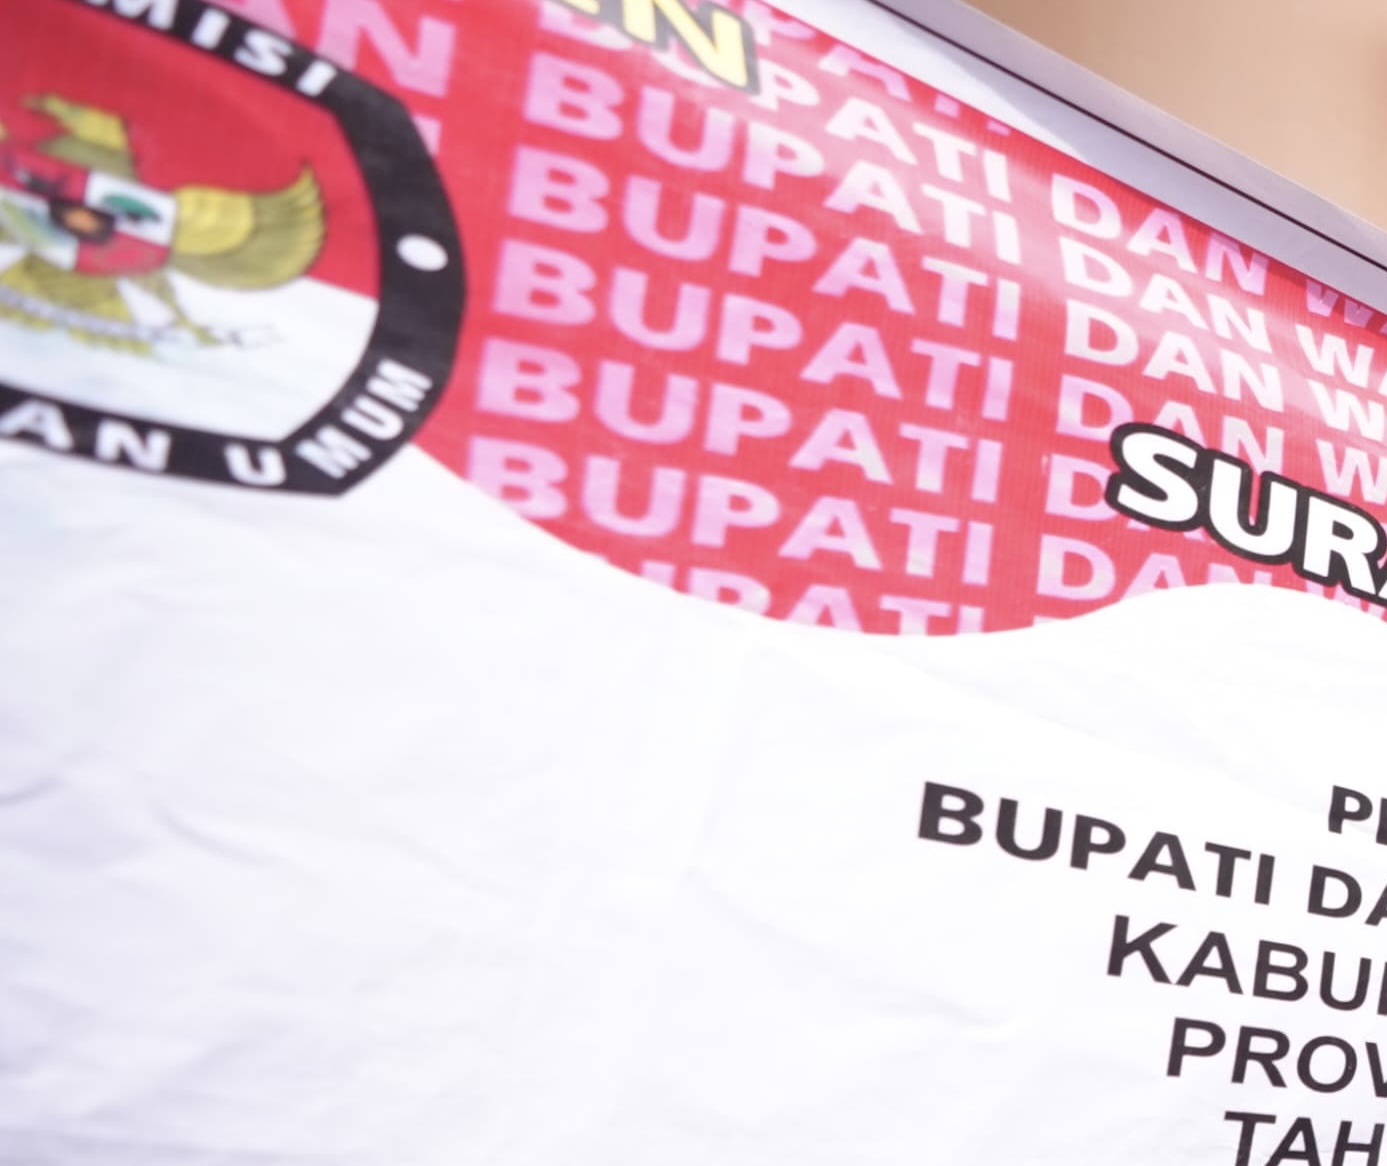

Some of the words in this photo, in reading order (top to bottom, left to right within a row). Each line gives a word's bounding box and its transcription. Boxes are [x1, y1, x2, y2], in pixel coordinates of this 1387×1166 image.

[506, 144, 1022, 342] BUPATI
[1064, 297, 1285, 413] DAN
[521, 50, 1023, 267] BUPATI
[1058, 235, 1274, 354] DAN
[1050, 172, 1271, 297] DAN
[222, 357, 434, 488] UMUM
[476, 337, 1003, 502] BUPATI
[491, 238, 1014, 422] BUPATI
[1056, 373, 1285, 476] DAN
[466, 435, 994, 588] BUPATI
[917, 781, 1276, 905] BUPATI
